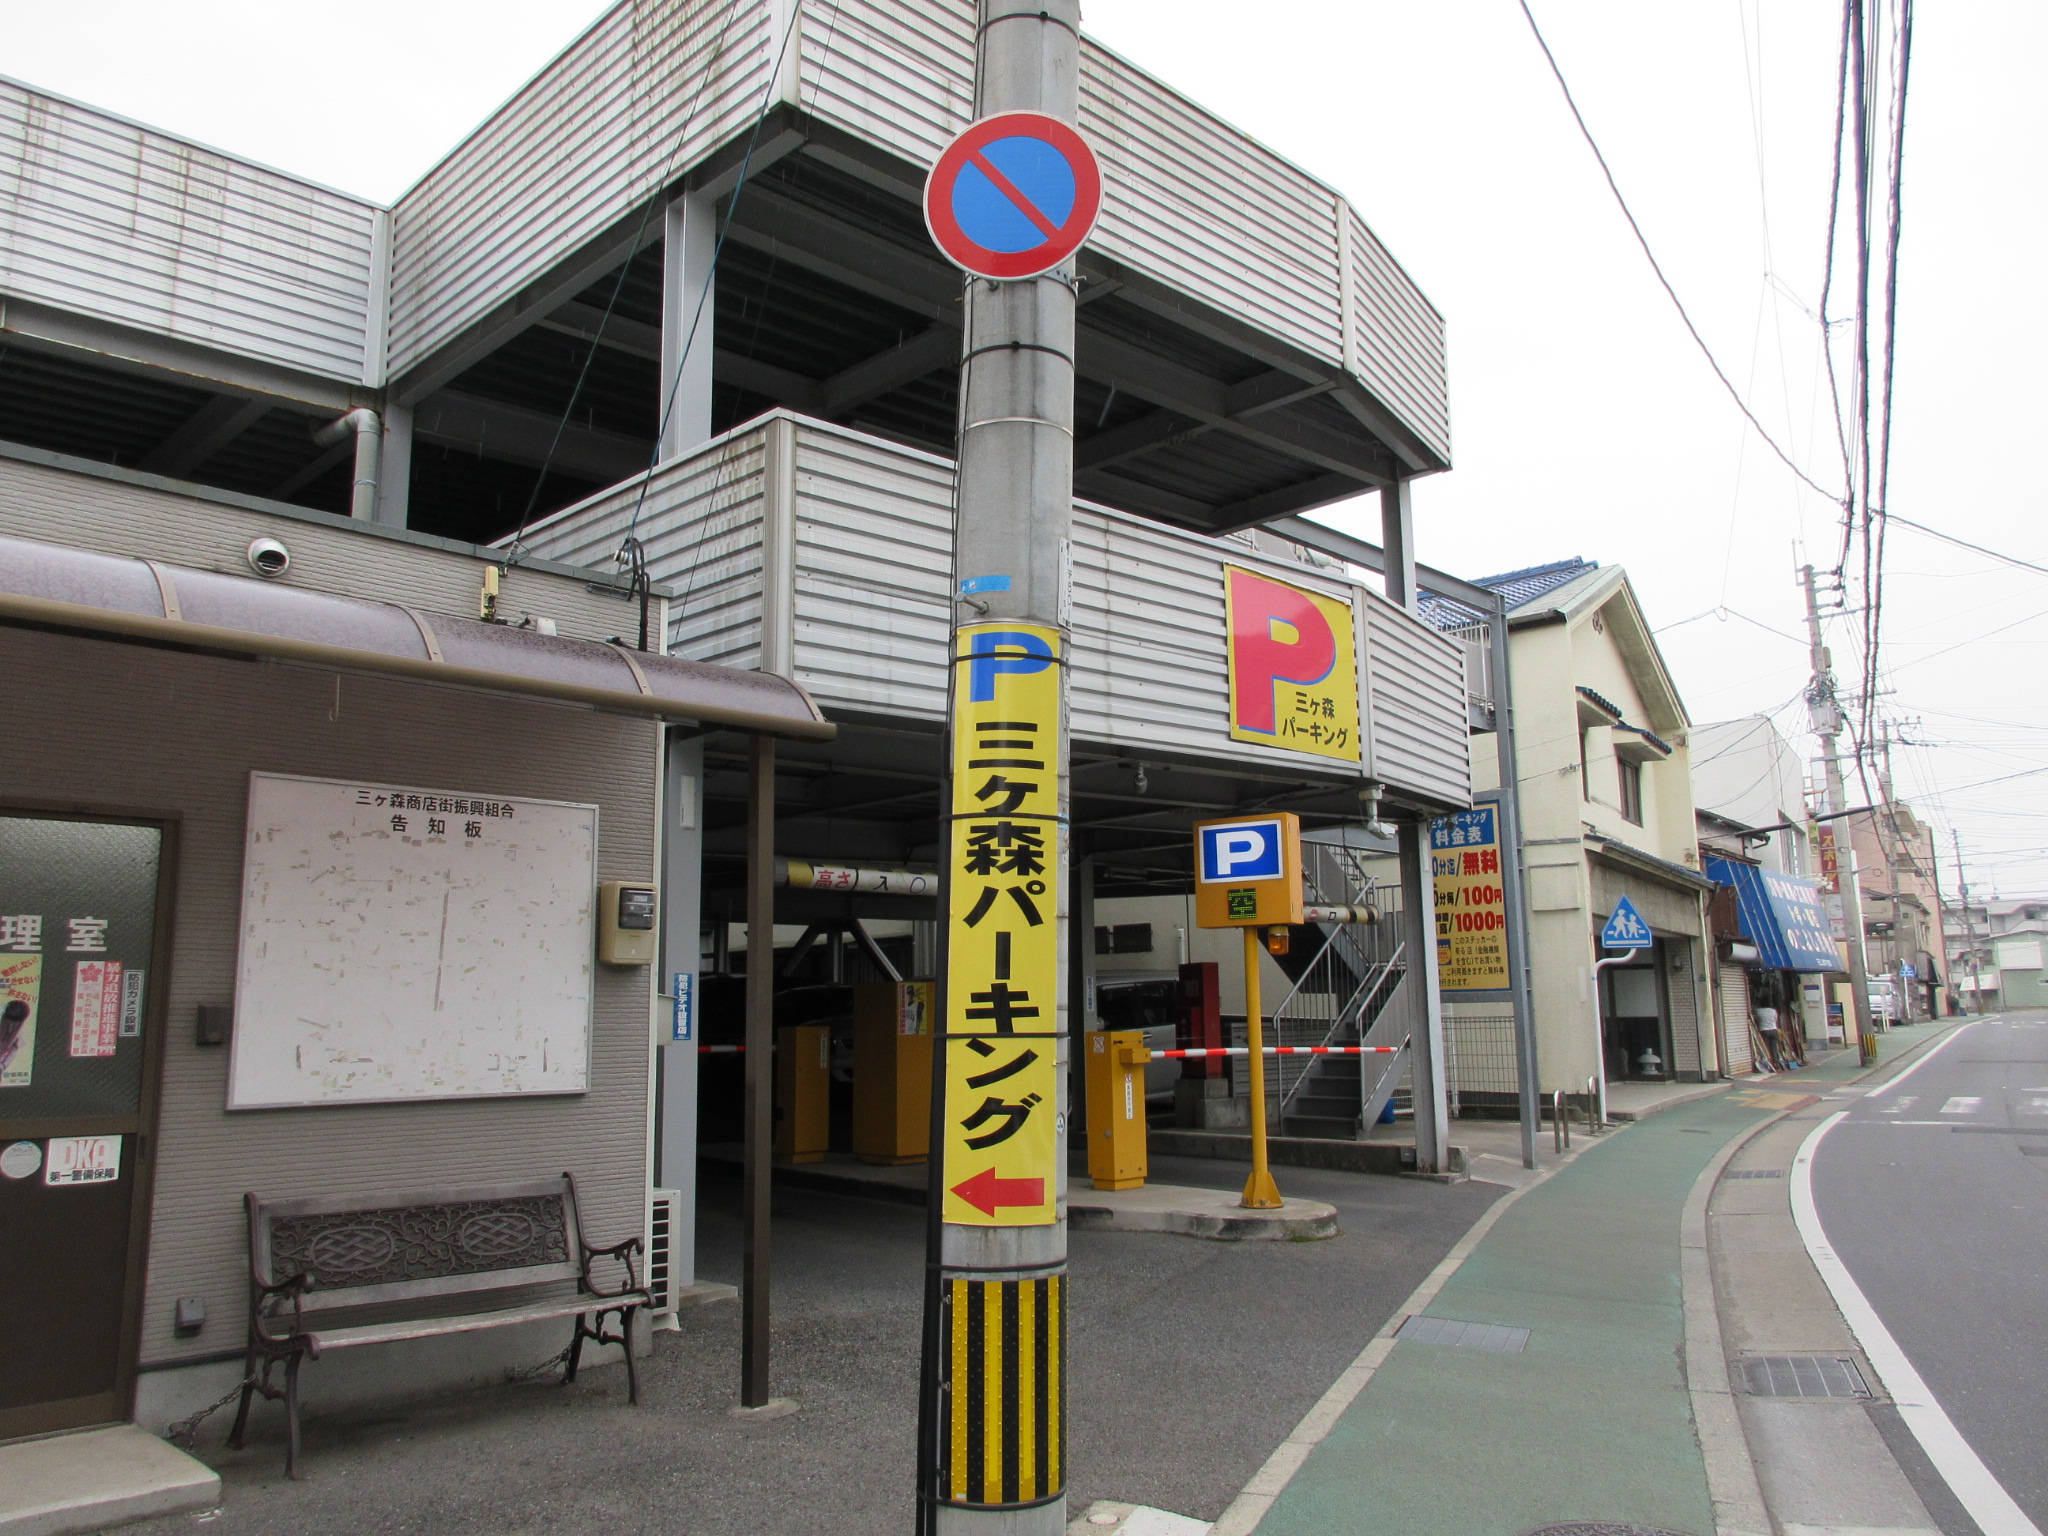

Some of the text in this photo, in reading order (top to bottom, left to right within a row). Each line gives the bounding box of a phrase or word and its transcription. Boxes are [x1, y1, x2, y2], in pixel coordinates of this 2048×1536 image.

[969, 631, 1054, 703] P
[1230, 570, 1336, 736] P
[1282, 716, 1349, 750] パーキング
[390, 814, 482, 839] 告知板
[1435, 826, 1482, 847] 料金表
[1215, 830, 1266, 876] P
[813, 870, 851, 890] 高さ
[1228, 888, 1257, 919] 空
[124, 972, 140, 1033] 防犯カメラ設置
